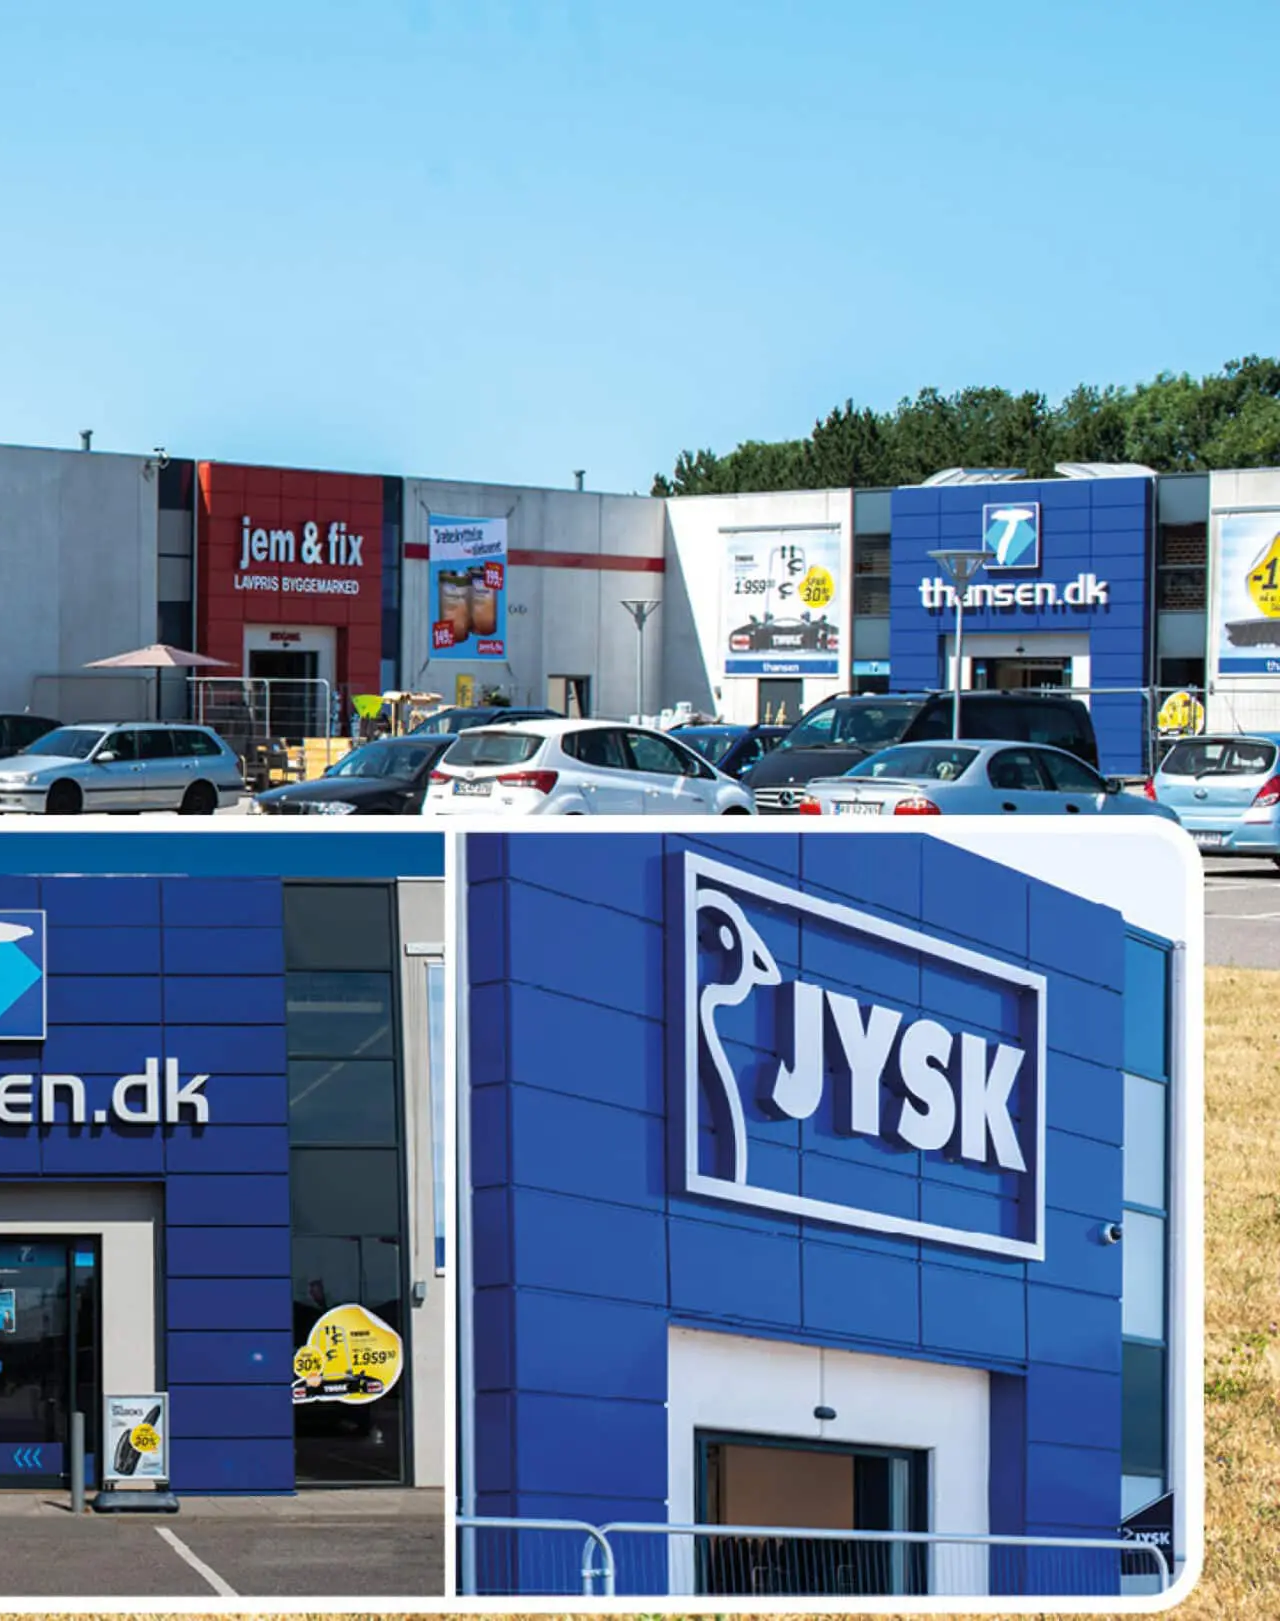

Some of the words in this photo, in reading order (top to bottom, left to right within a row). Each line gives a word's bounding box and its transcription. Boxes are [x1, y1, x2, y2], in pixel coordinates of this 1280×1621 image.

[239, 515, 296, 570] jem
[301, 521, 323, 564] &
[327, 521, 364, 566] fix
[234, 574, 279, 591] LAVPRIS
[281, 576, 360, 595] BYGGEMARKED
[762, 663, 800, 673] thansen
[771, 979, 1028, 1173] JYSK
[296, 1358, 322, 1372] 30%
[352, 1351, 388, 1367] 1.959
